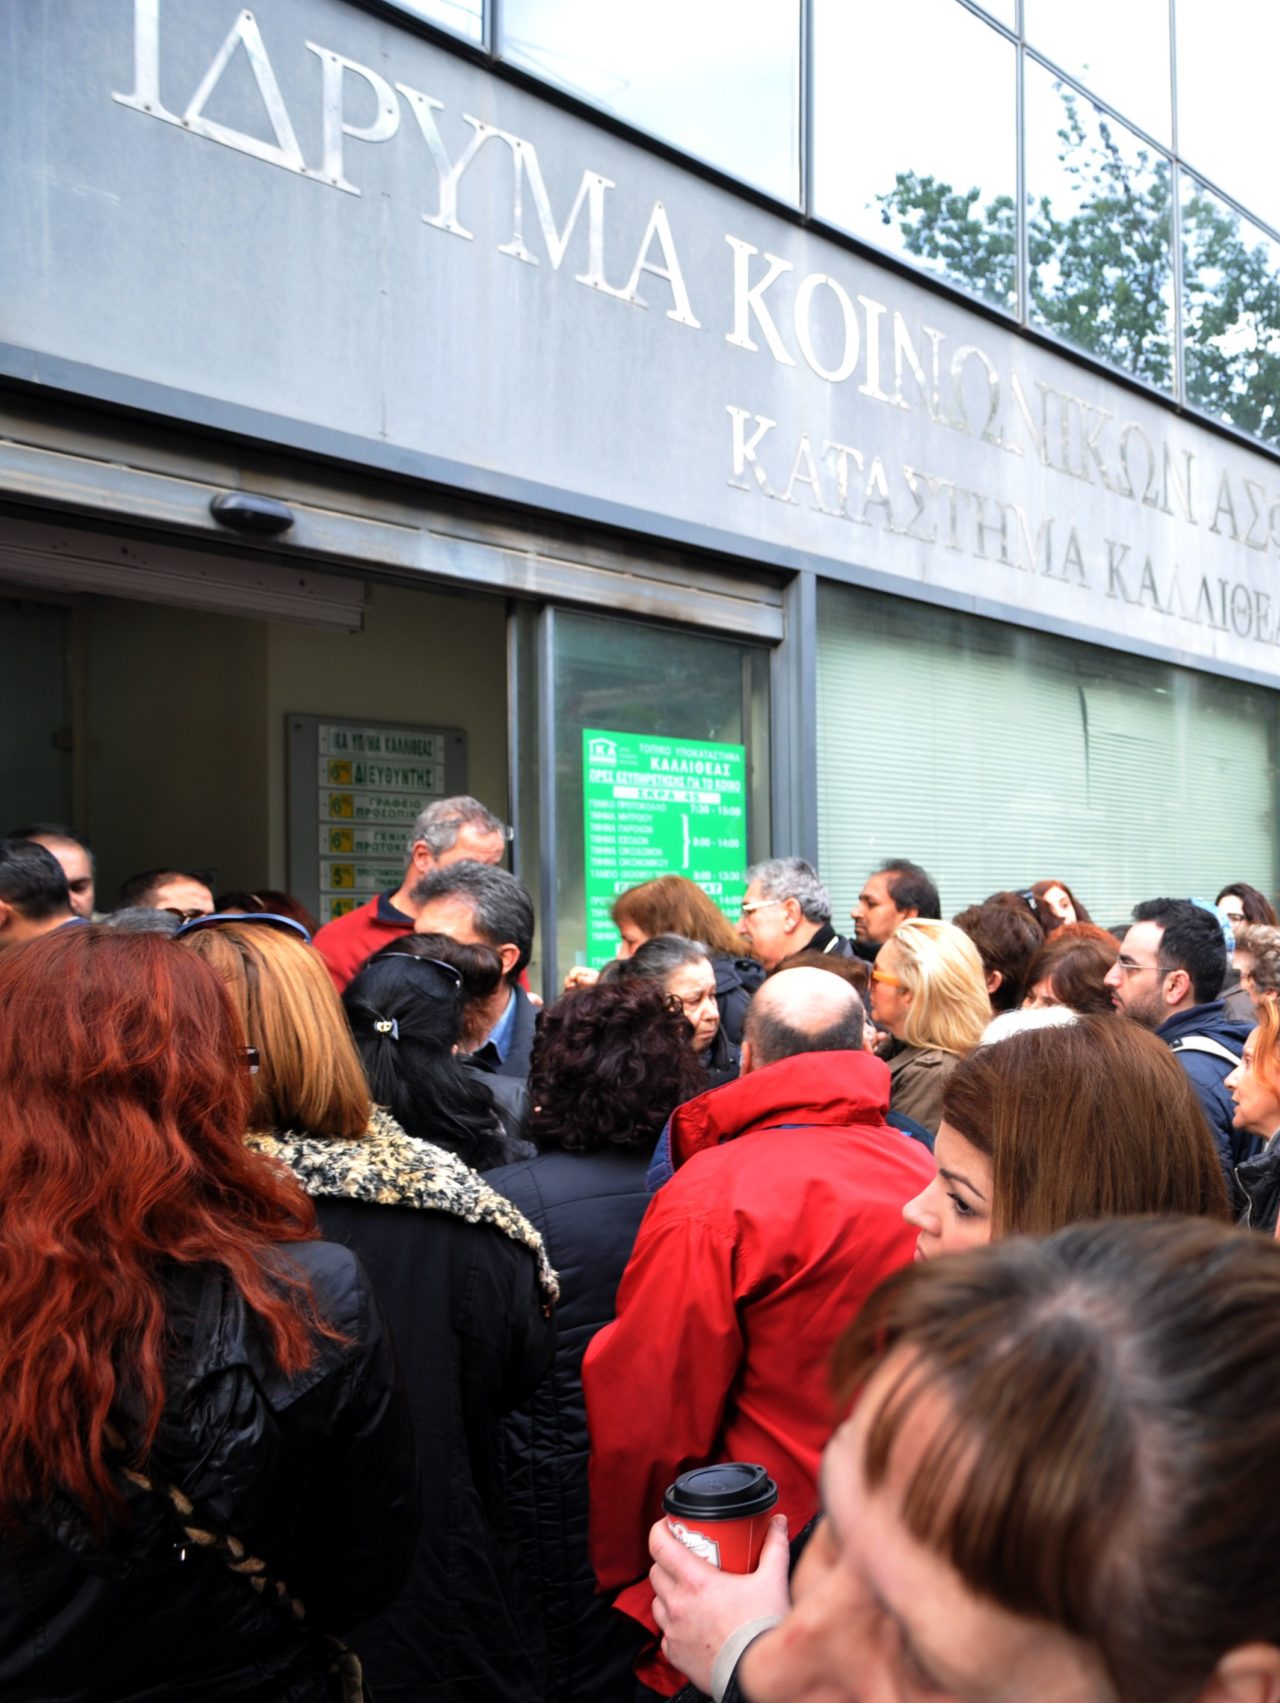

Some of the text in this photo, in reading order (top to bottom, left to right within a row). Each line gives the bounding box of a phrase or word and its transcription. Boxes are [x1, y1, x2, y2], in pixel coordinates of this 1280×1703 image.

[725, 234, 1198, 525] ΚΟΙΝΩΝΙΚΩΝ
[725, 405, 1092, 590] ΚΑΤΑΣΤΗΜΑ
[355, 762, 433, 789] ΔΙΕΥΘΥΝΤΗΣ
[650, 756, 731, 777] ΚΑΛΛΙΘΕΑΣ
